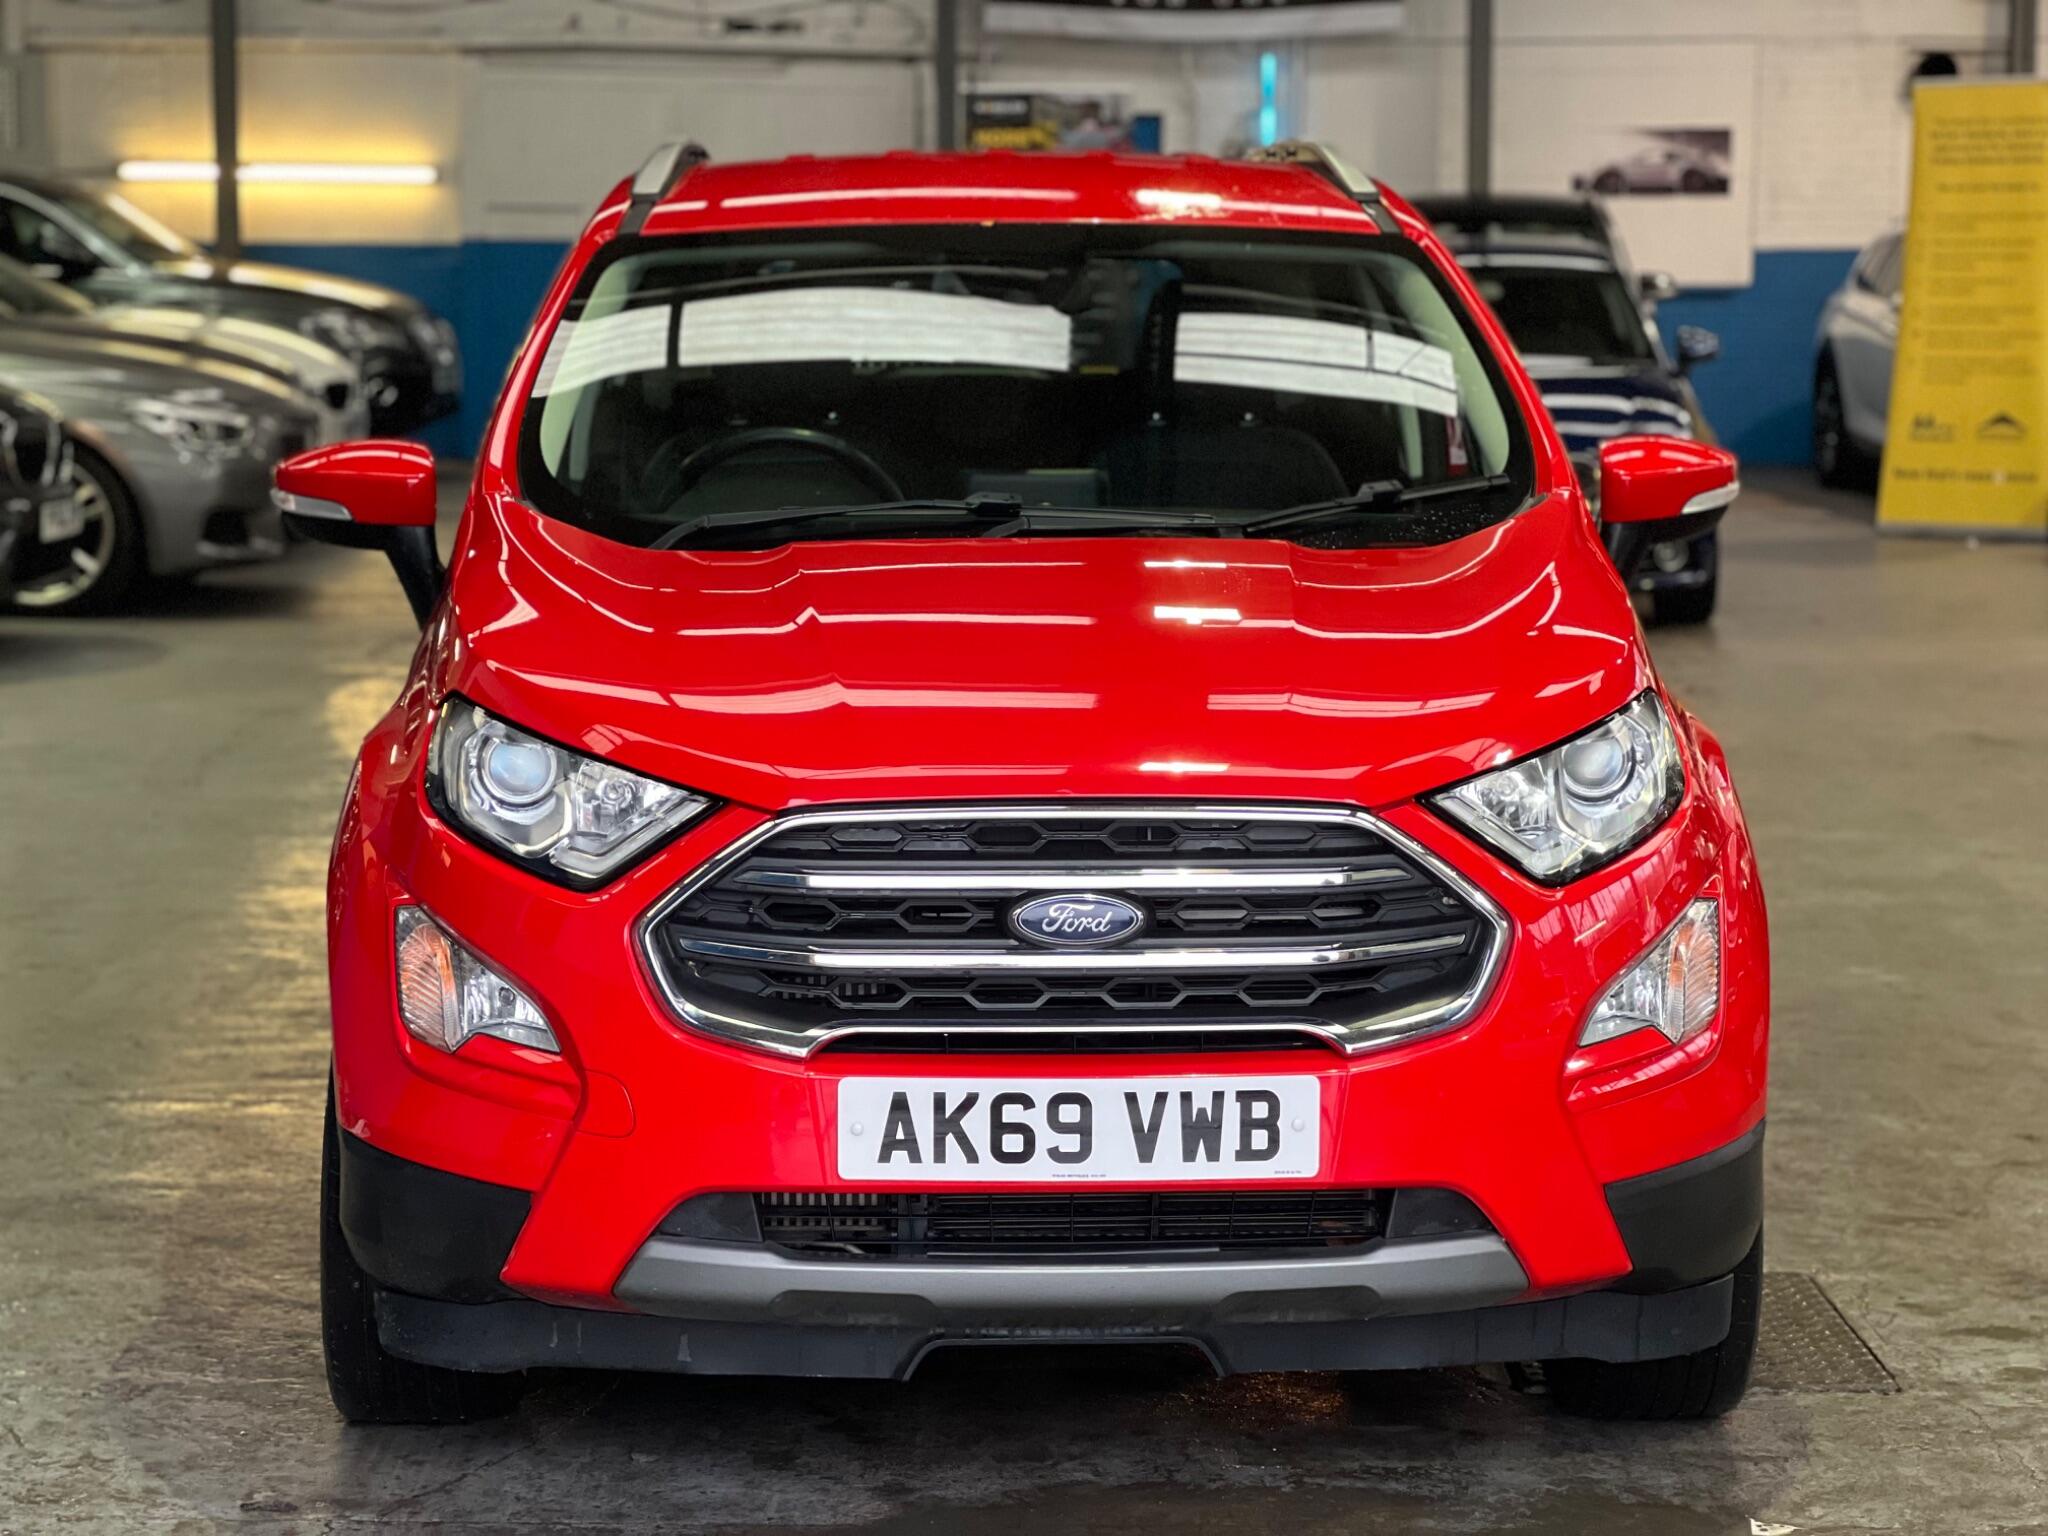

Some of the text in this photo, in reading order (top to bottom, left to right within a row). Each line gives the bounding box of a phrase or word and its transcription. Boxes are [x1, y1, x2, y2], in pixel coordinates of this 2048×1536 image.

[1041, 902, 1112, 933] Ford
[877, 1089, 1282, 1164] AK69 VWB
